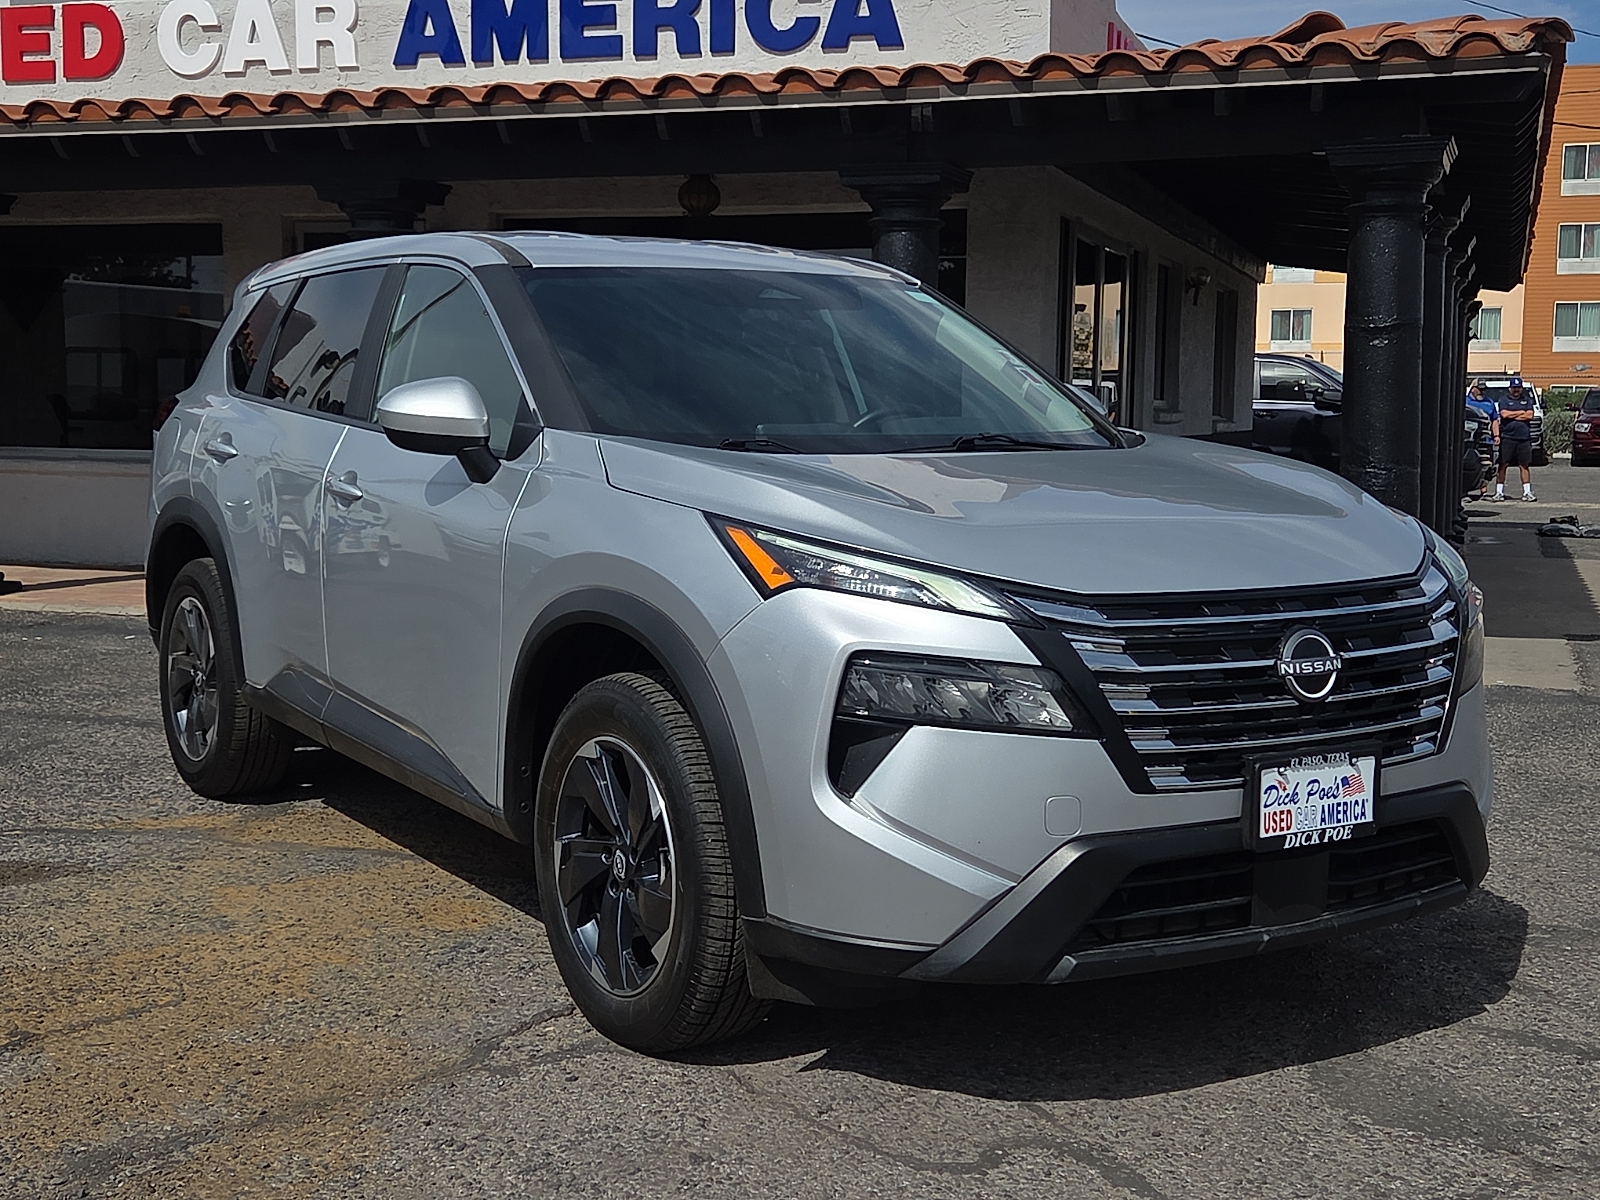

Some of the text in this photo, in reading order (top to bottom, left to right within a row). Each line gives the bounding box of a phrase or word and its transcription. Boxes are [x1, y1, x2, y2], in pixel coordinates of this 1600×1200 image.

[1, 0, 904, 82] ED CAR AMERICA
[1280, 659, 1341, 674] NISSAN
[1290, 756, 1301, 769] EL
[1326, 752, 1350, 764] TEXAS
[1263, 775, 1341, 809] Dick Poe's
[1263, 799, 1367, 835] USED CAR AMERICA
[1283, 825, 1353, 849] DICK POE
